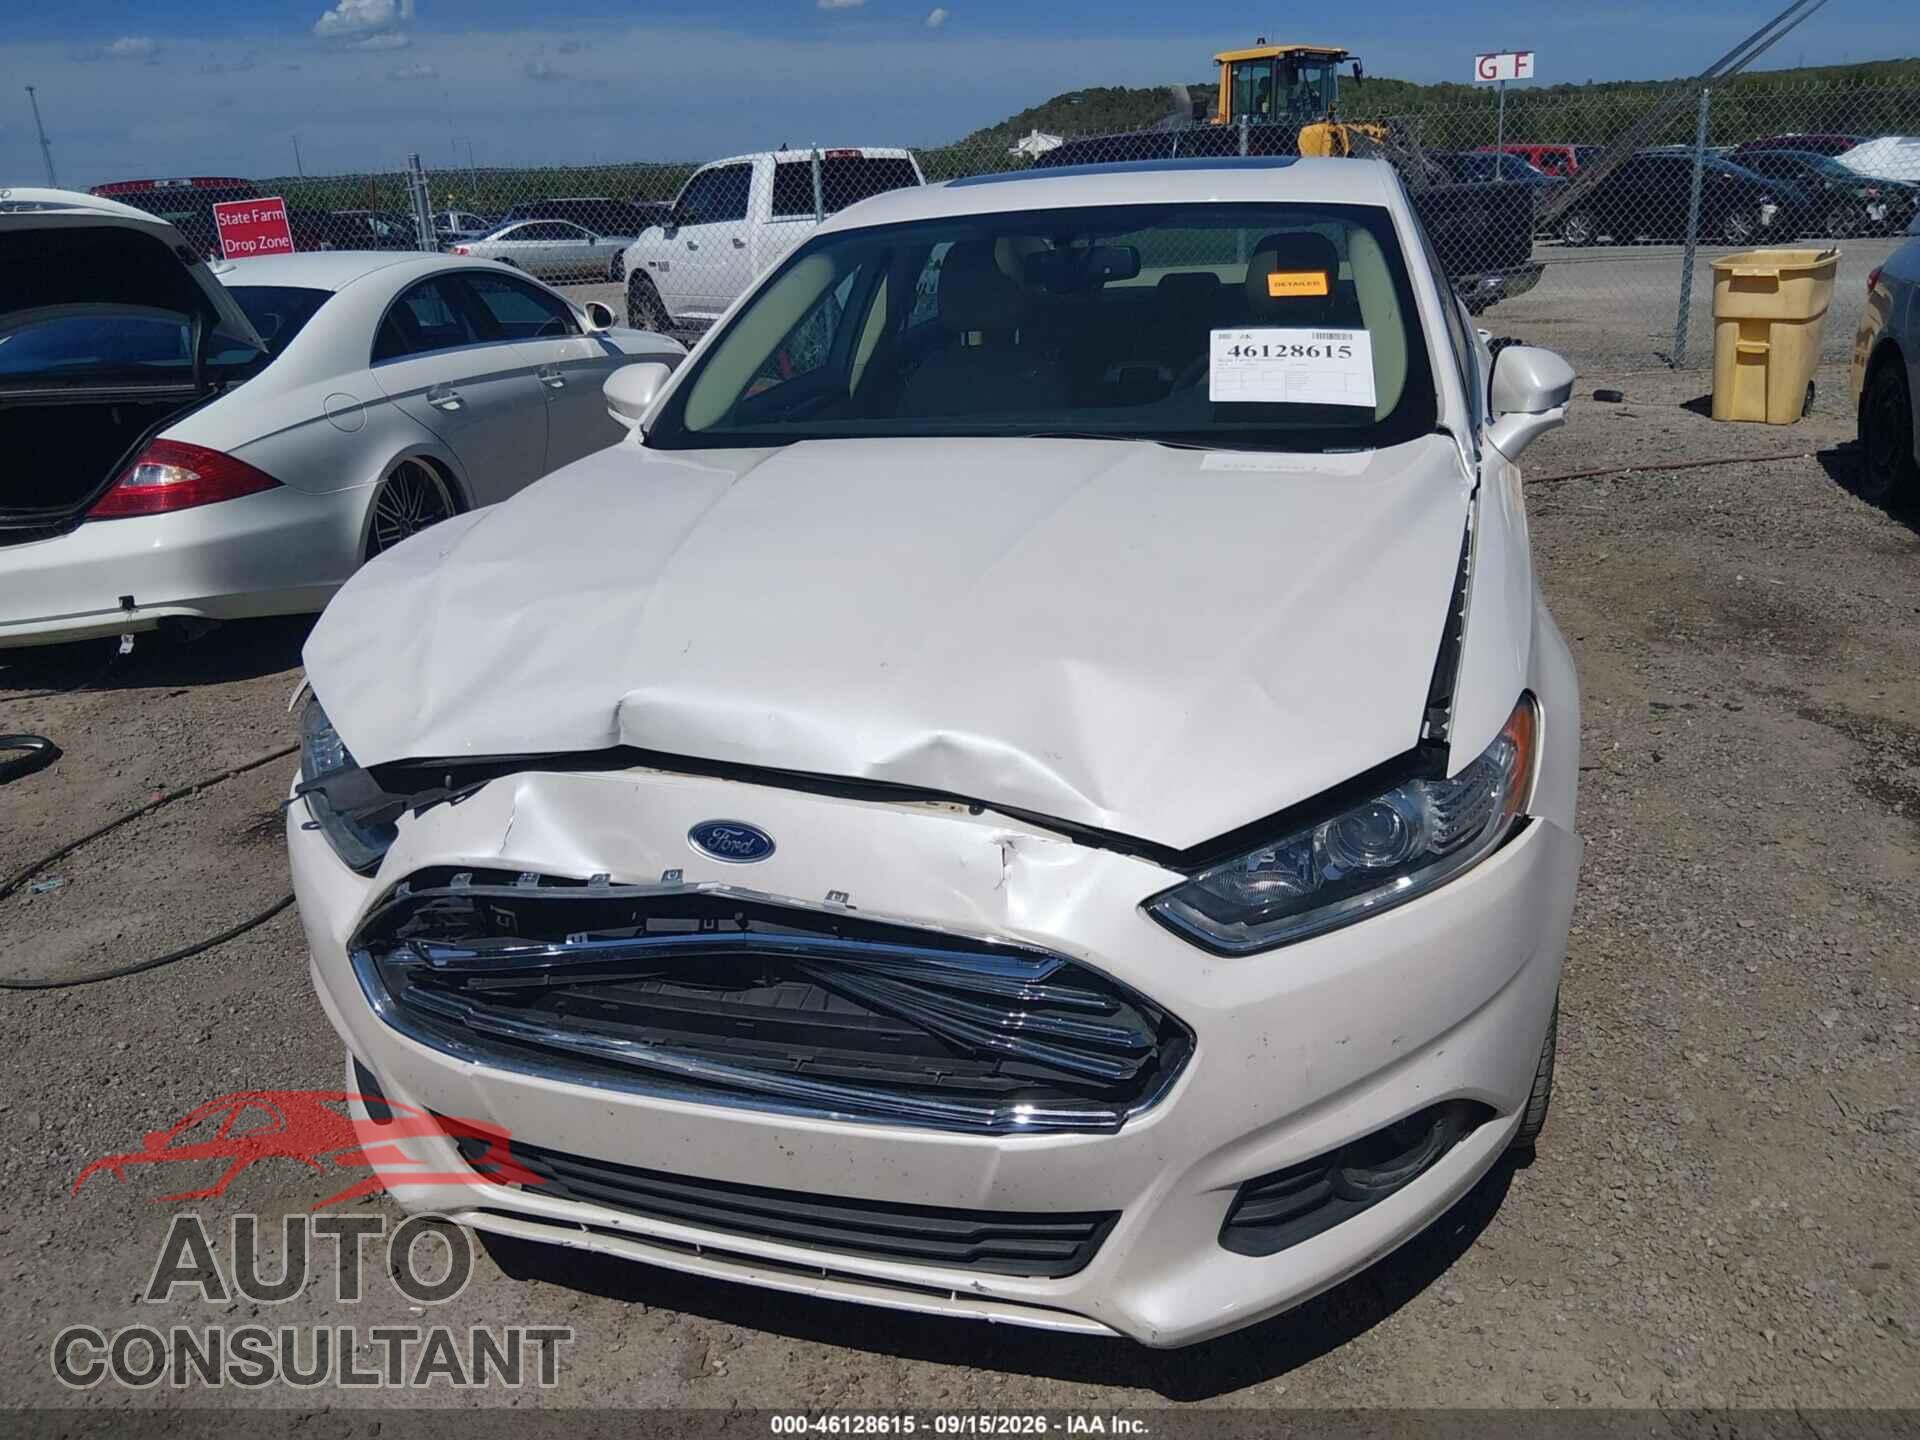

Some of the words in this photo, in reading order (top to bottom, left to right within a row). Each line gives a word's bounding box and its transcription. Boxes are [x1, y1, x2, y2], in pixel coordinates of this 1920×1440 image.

[1479, 55, 1497, 79] G
[1515, 52, 1528, 77] F
[218, 212, 250, 226] State
[252, 209, 284, 222] Farm
[225, 239, 257, 253] Drop
[258, 235, 290, 249] Zone
[1227, 344, 1353, 360] 46128615
[707, 827, 756, 854] Ford
